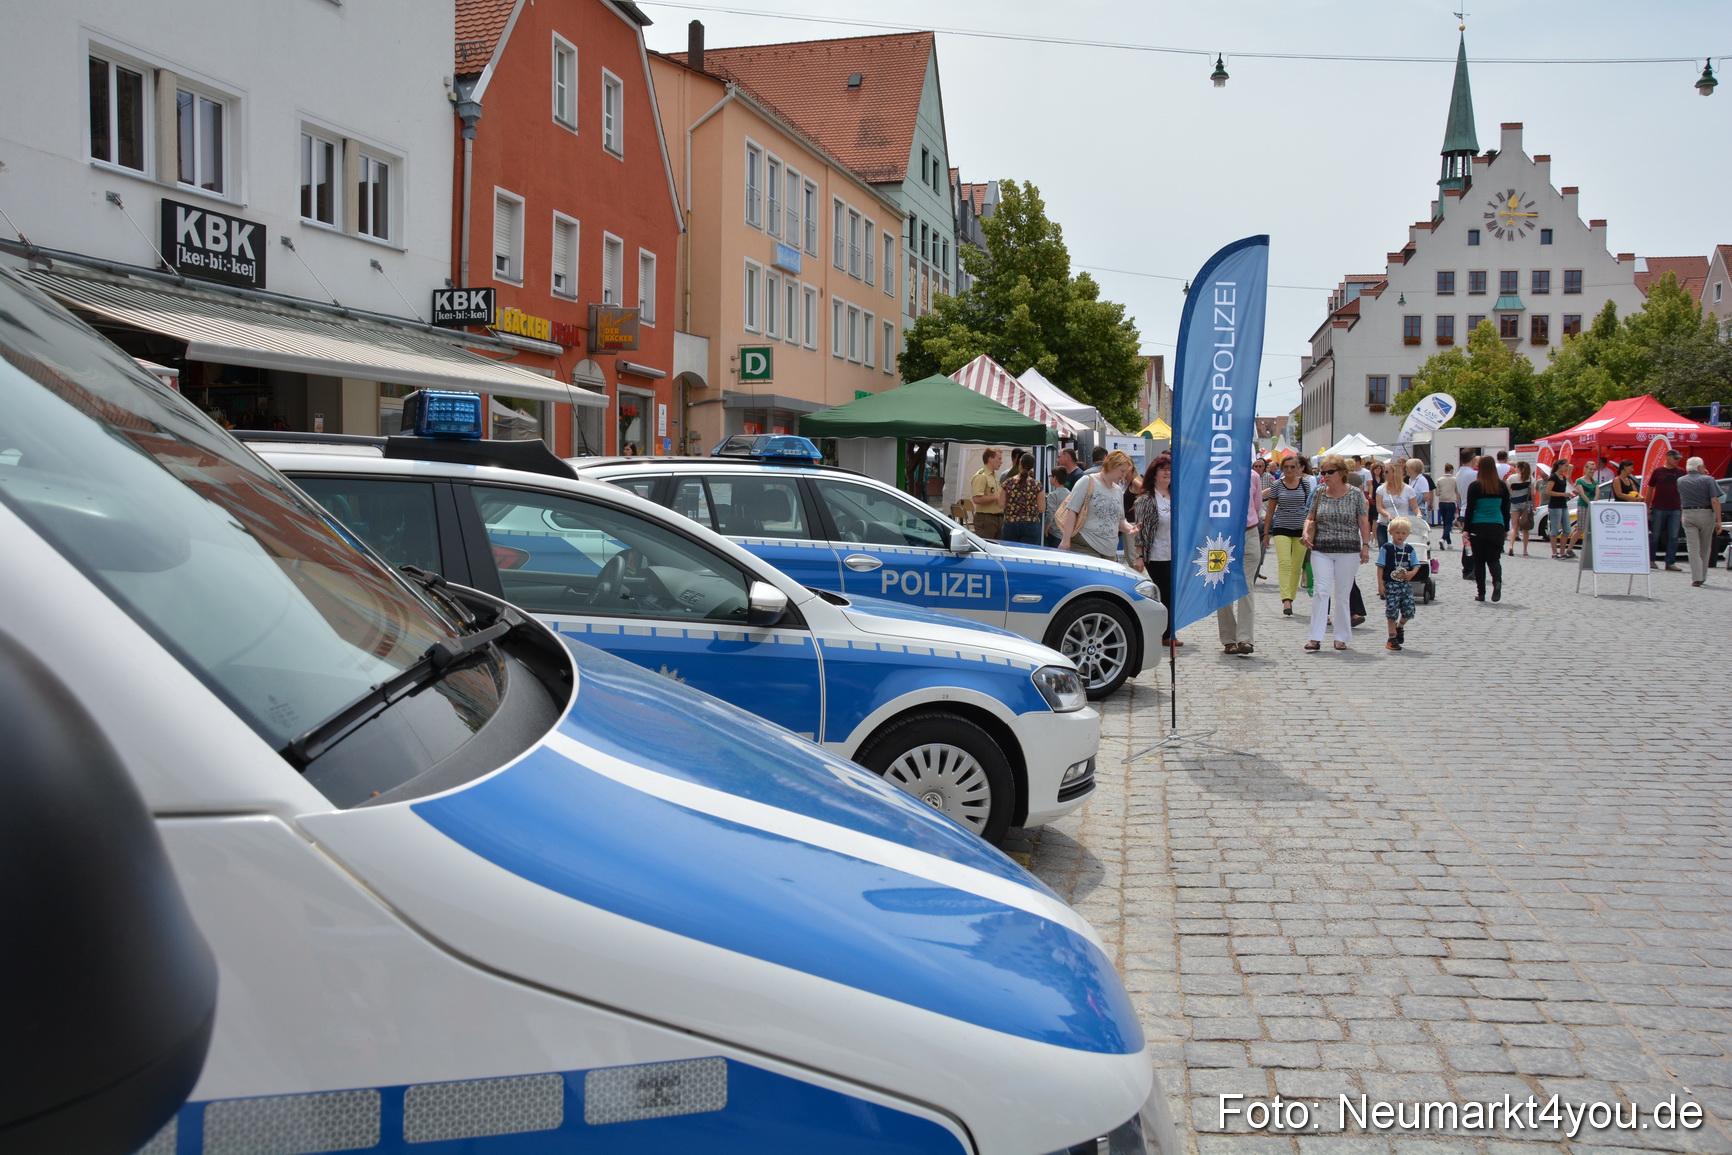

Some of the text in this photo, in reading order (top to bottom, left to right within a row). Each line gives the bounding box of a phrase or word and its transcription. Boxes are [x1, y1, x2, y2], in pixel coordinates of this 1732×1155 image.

[176, 205, 256, 260] KBK
[435, 290, 488, 311] KBK
[503, 307, 549, 341] BÄCKER
[745, 352, 767, 375] D
[1208, 280, 1237, 519] BUNDESPOLIZEI
[881, 569, 992, 599] POLIZEI
